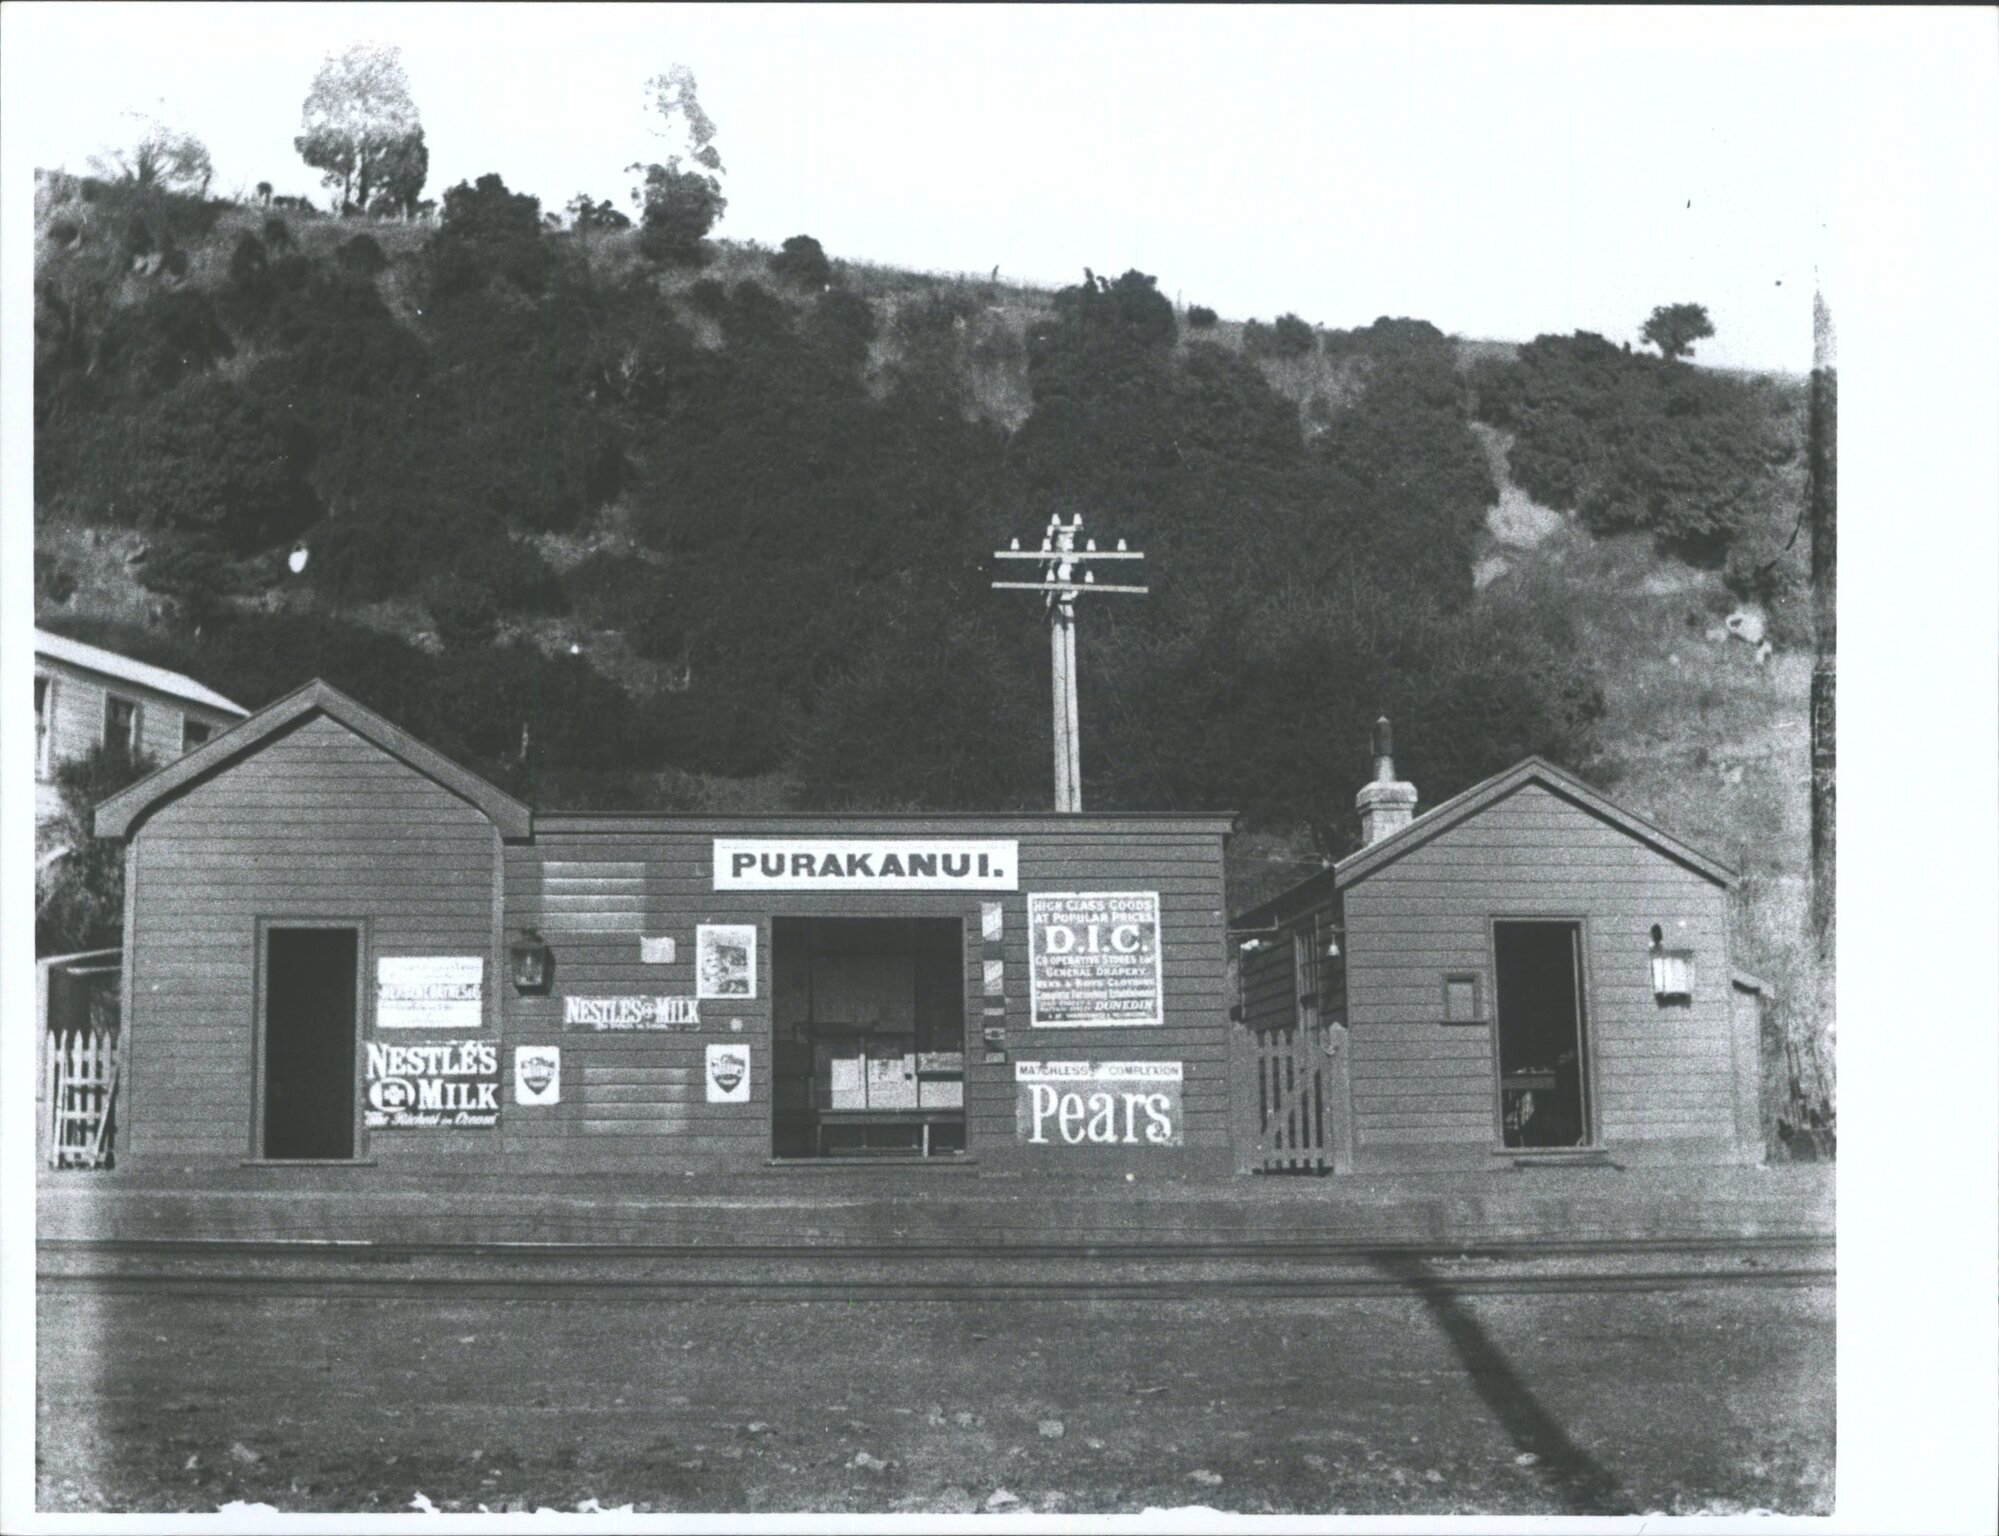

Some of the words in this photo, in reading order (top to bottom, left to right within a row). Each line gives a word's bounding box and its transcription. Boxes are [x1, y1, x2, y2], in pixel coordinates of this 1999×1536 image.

[731, 852, 1005, 878] PURAKANUI.
[1033, 901, 1062, 911] HIGH
[1066, 900, 1105, 910] CLASS
[1110, 899, 1153, 910] GOODS
[1045, 924, 1149, 954] D.I.C.
[1046, 967, 1091, 977] GENERAL
[656, 997, 700, 1023] MILK
[1109, 1065, 1179, 1075] COMPLEXION
[418, 1079, 499, 1110] MILK
[1027, 1084, 1172, 1143] Pears
